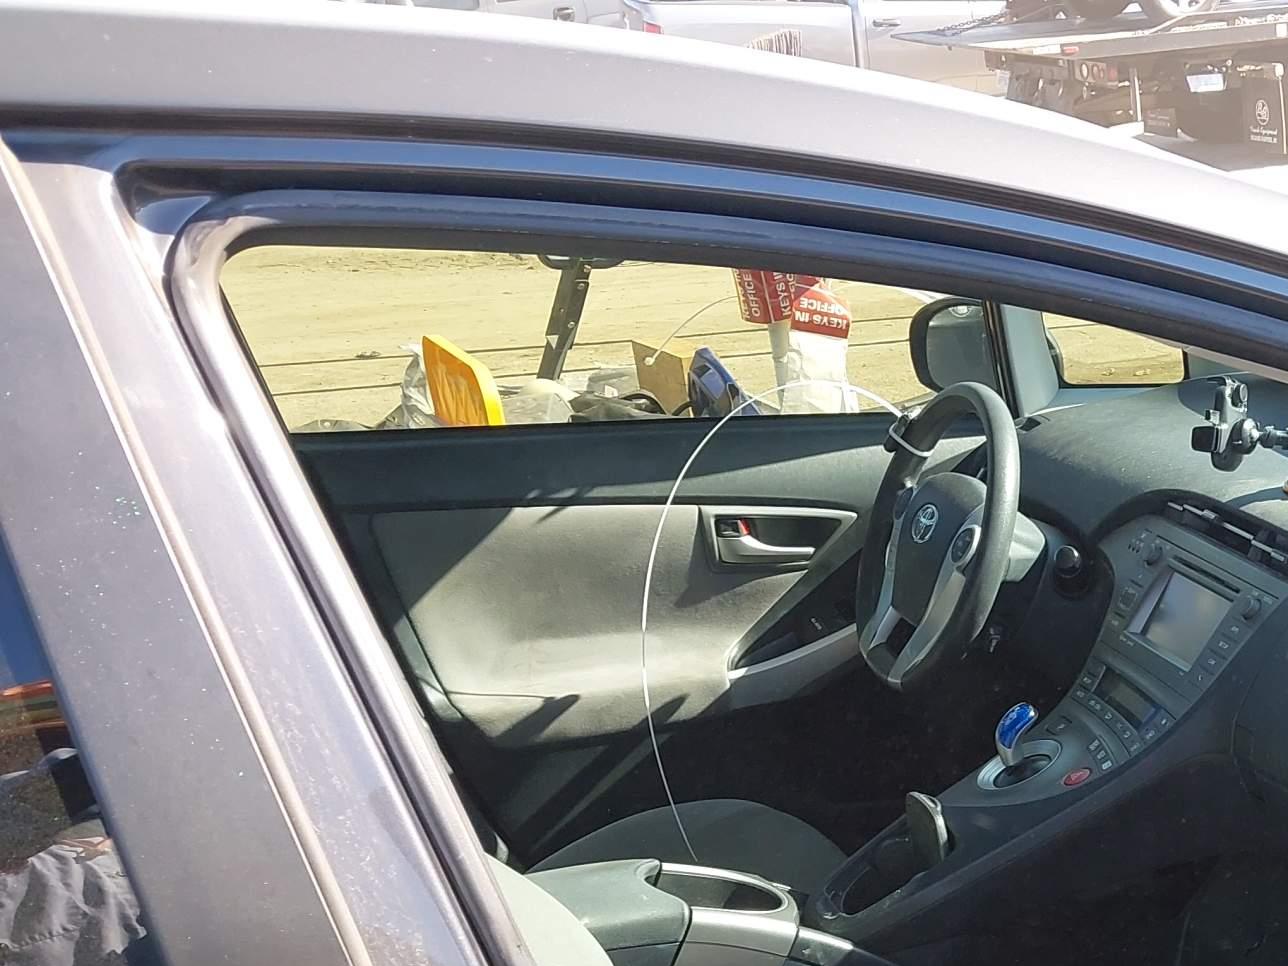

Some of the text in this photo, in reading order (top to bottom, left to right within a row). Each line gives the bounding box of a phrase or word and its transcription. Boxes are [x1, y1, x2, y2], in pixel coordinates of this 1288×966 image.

[743, 273, 760, 317] OFFICE
[775, 282, 791, 316] KEYS
[800, 298, 847, 315] OFFICE
[795, 310, 847, 329] KEYS IN
